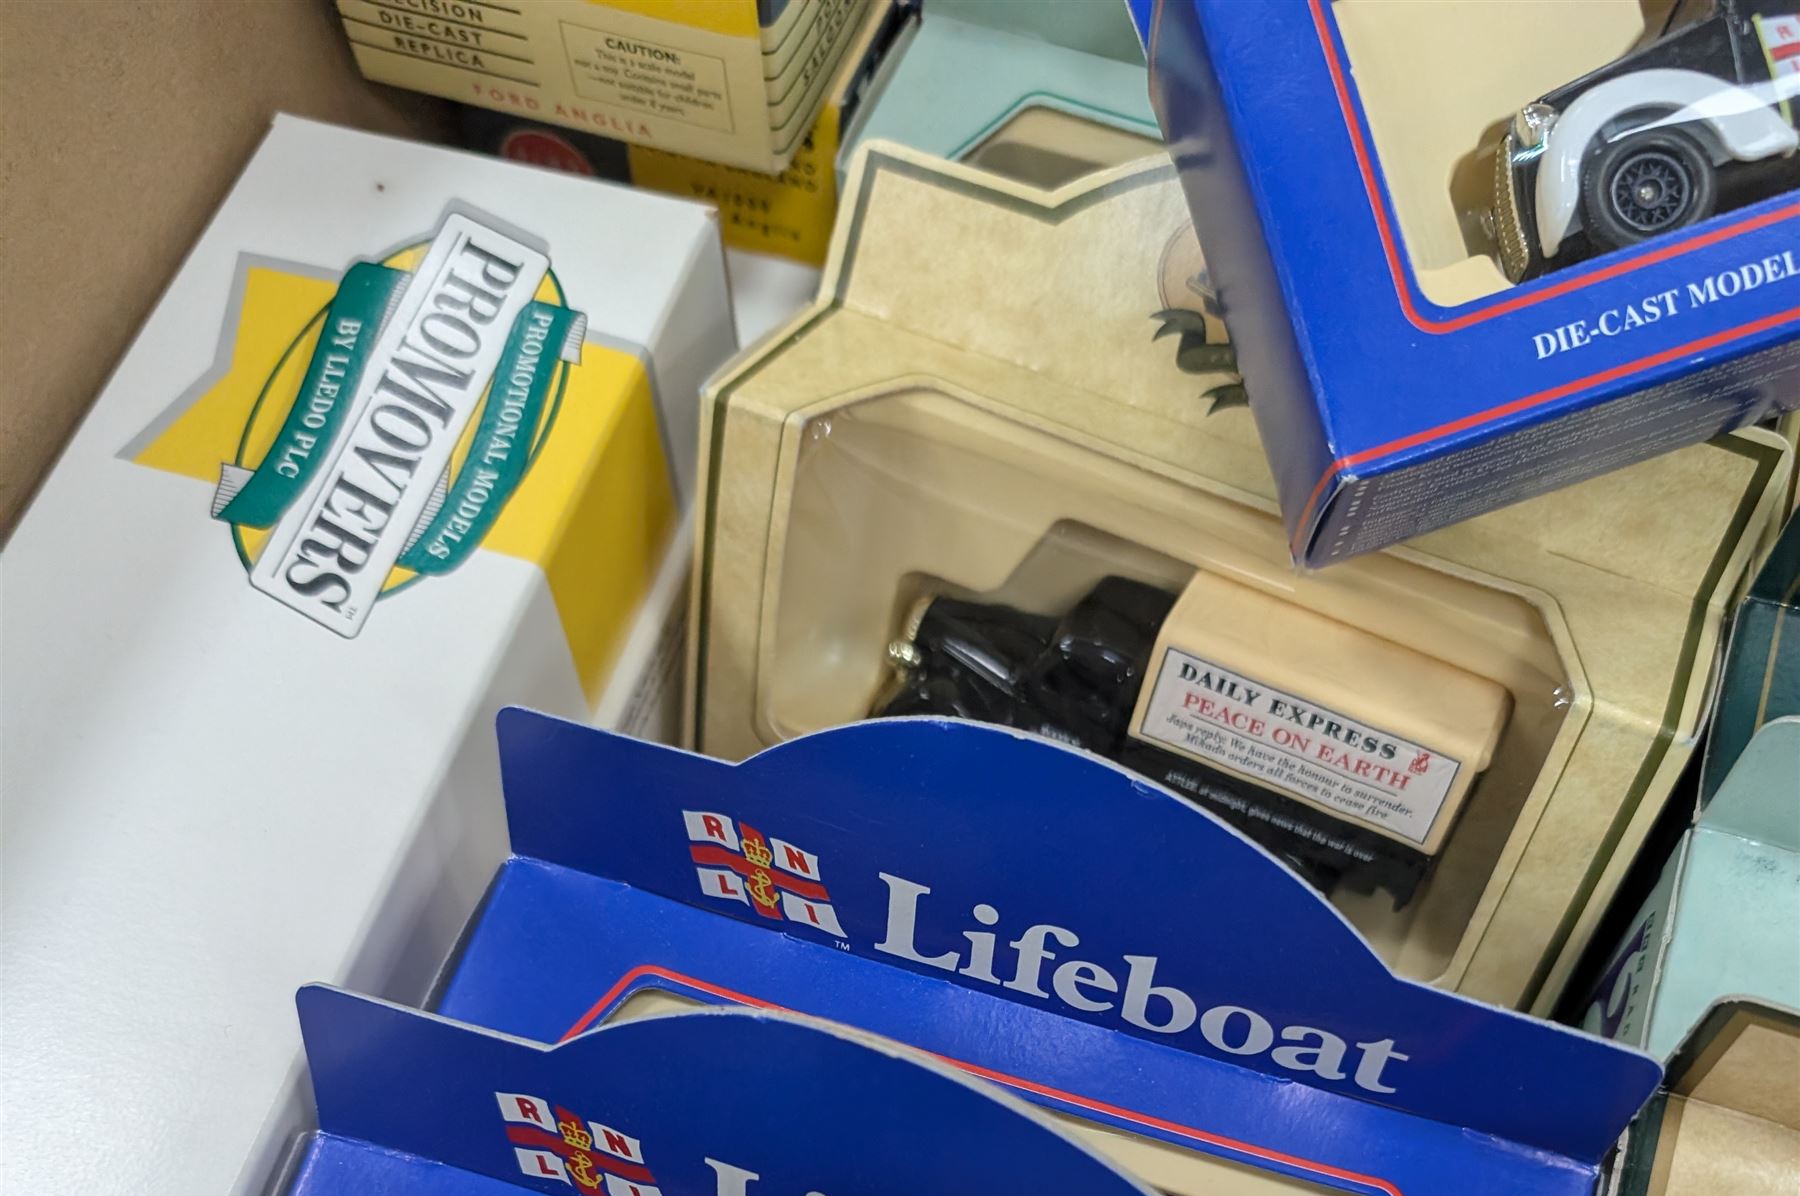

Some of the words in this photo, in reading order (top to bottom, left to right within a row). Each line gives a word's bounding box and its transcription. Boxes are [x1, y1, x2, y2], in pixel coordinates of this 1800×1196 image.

[378, 10, 483, 46] DIE-CAST
[394, 0, 484, 23] CISION
[393, 36, 485, 69] REPLICA
[605, 37, 681, 65] CAUTION:
[472, 82, 540, 111] FORD
[553, 104, 653, 139] ANGLIA
[1532, 286, 1679, 360] DIE-CAST
[1686, 250, 1800, 309] MODEL
[338, 317, 363, 354] BY
[302, 351, 351, 430] LLEDO
[491, 311, 555, 474] PROMOTIONAL
[276, 430, 317, 480] PLC
[285, 236, 525, 616] PROMOVERS
[427, 468, 500, 560] MODELS
[1178, 661, 1262, 706] DAILY
[1267, 697, 1398, 761] EXPRESS
[1183, 691, 1266, 738] PEACE
[1271, 727, 1312, 753] ON
[1316, 743, 1411, 791] EARTH
[1227, 752, 1266, 772] orders
[1266, 765, 1286, 780] all
[1320, 786, 1333, 799] to
[1333, 793, 1366, 810] cease
[1365, 804, 1389, 820] fire
[1278, 755, 1297, 771] the
[1297, 764, 1340, 789] honour
[1340, 783, 1353, 795] to
[702, 815, 727, 842] R
[783, 844, 811, 875] N
[718, 873, 739, 896] L
[874, 870, 1409, 1095] Lifeboat
[515, 1097, 543, 1124] R
[602, 1128, 633, 1158] N
[535, 1154, 560, 1176] L
